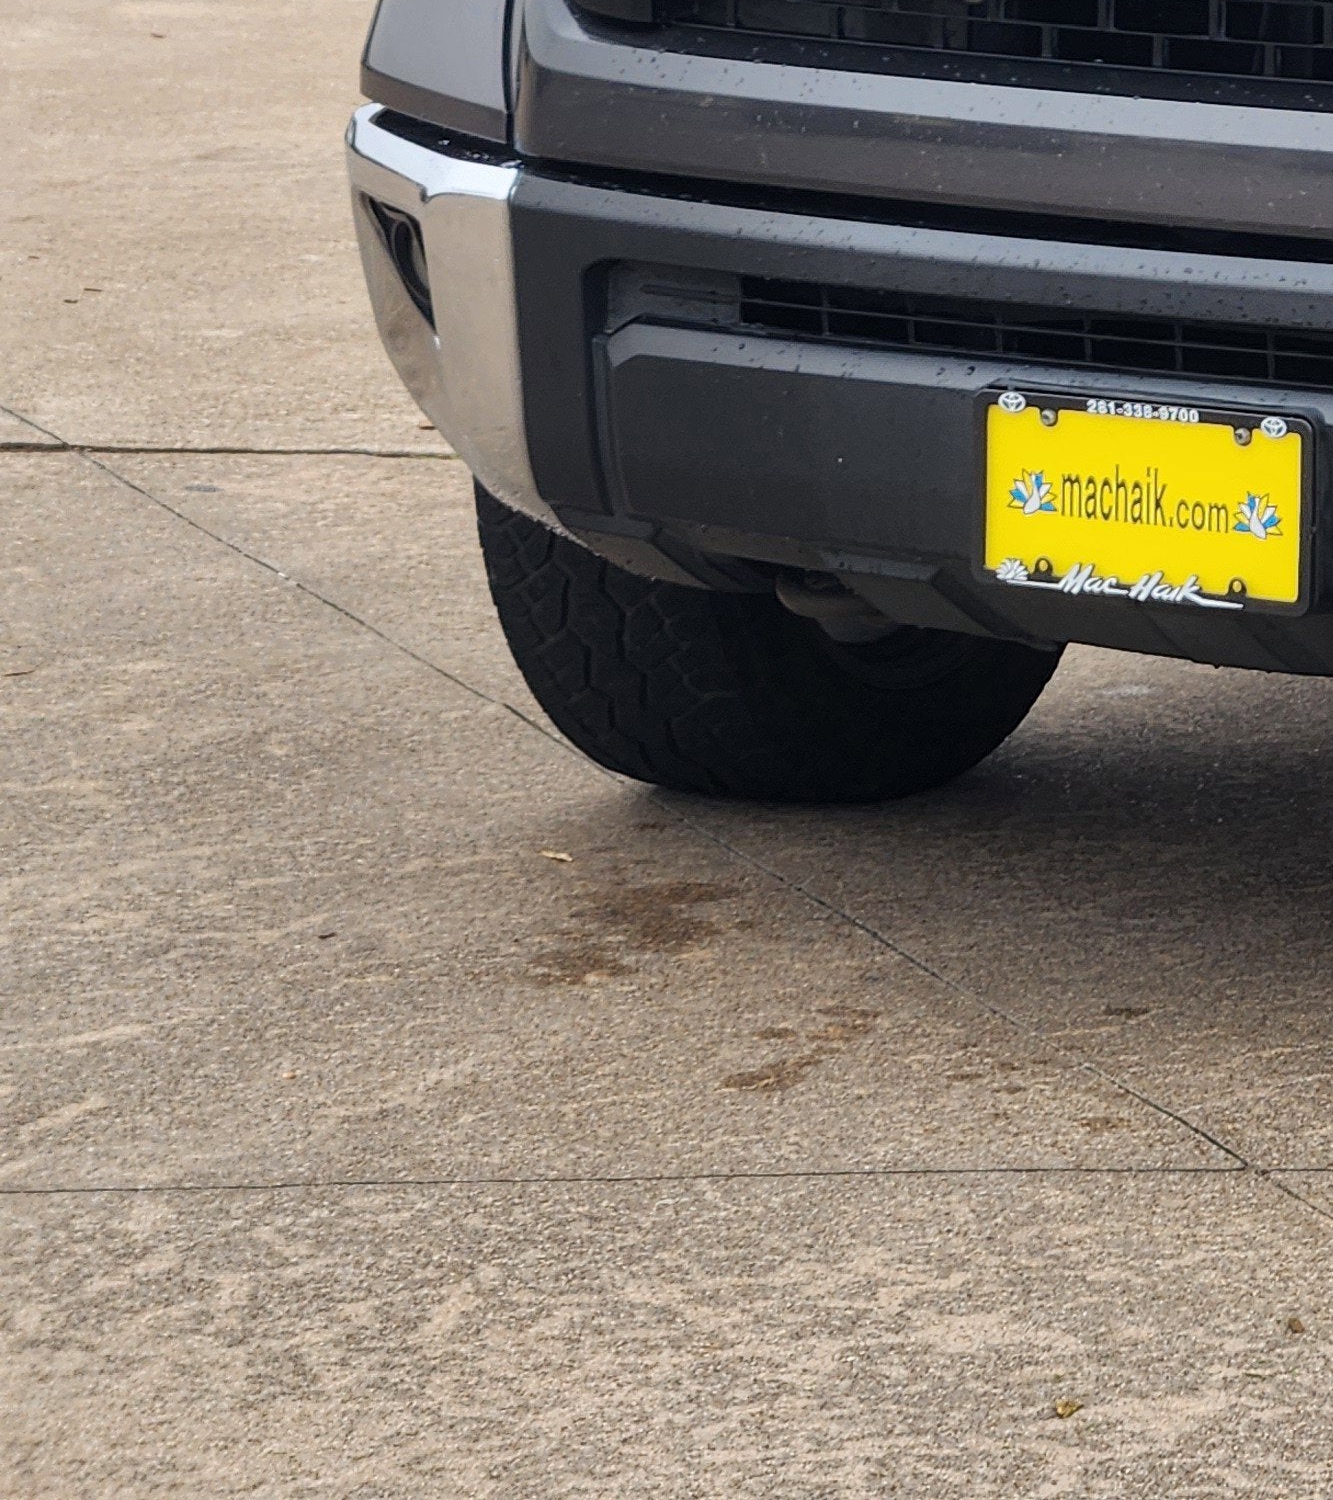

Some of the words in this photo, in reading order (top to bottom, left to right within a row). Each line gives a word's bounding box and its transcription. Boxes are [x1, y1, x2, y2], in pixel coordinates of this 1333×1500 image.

[1060, 464, 1230, 534] machaik.com
[1056, 562, 1130, 597] Mac
[1127, 570, 1208, 604] Haik
